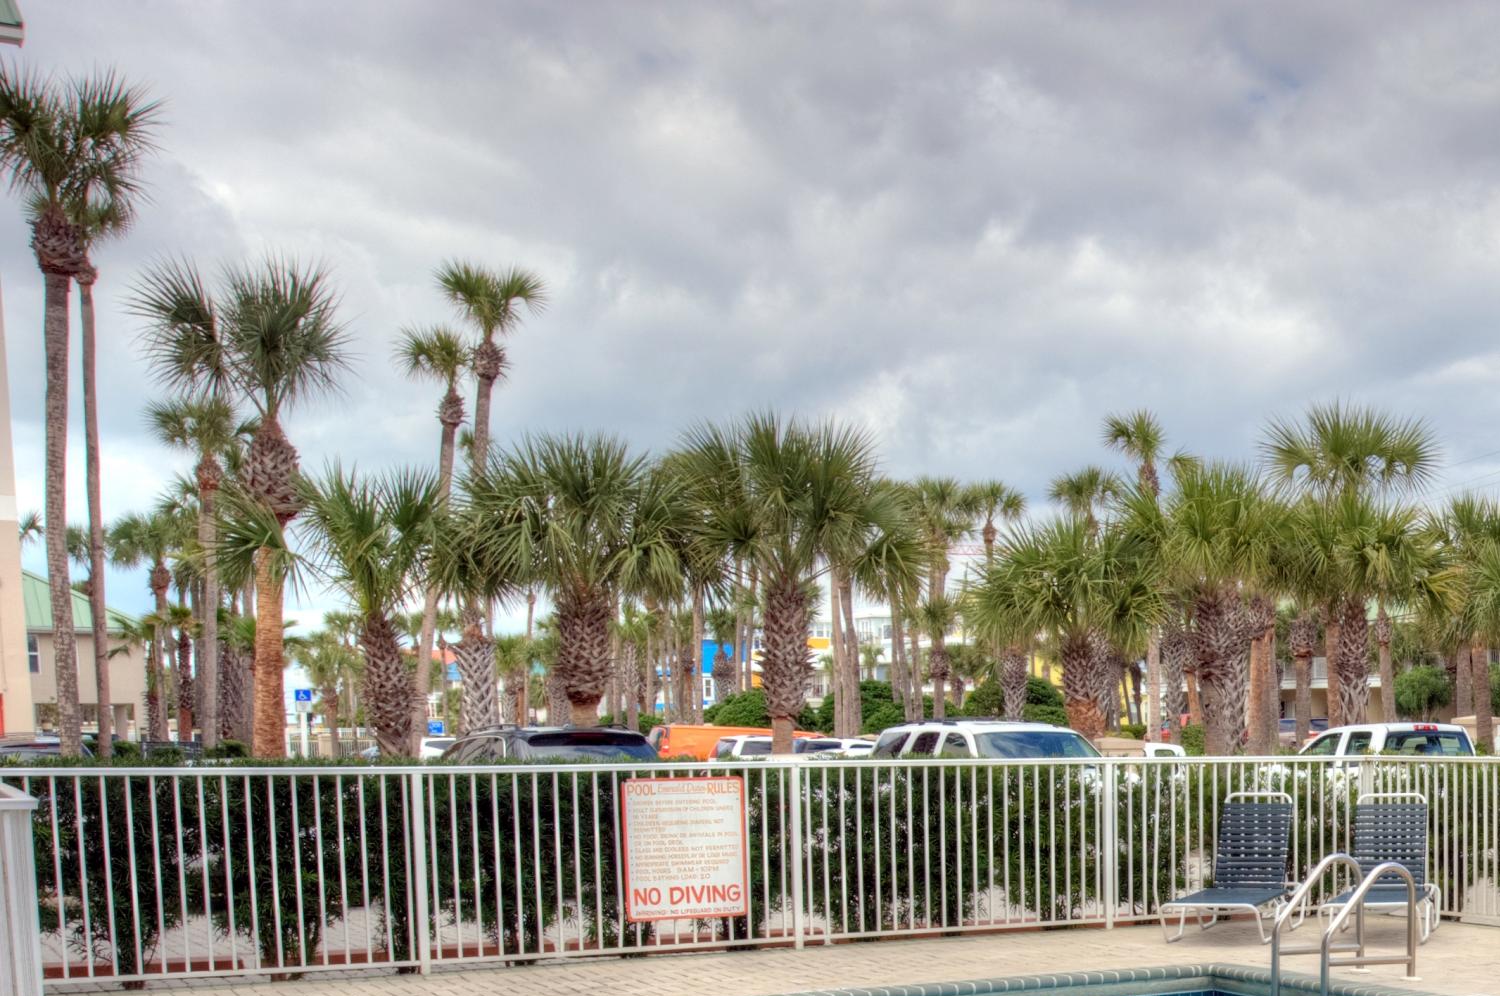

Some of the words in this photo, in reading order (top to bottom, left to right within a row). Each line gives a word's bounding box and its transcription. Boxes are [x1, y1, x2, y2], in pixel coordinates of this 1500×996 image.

[627, 784, 656, 796] POOL
[707, 782, 739, 795] RULES
[634, 888, 661, 906] NO
[669, 884, 741, 905] DIVING
